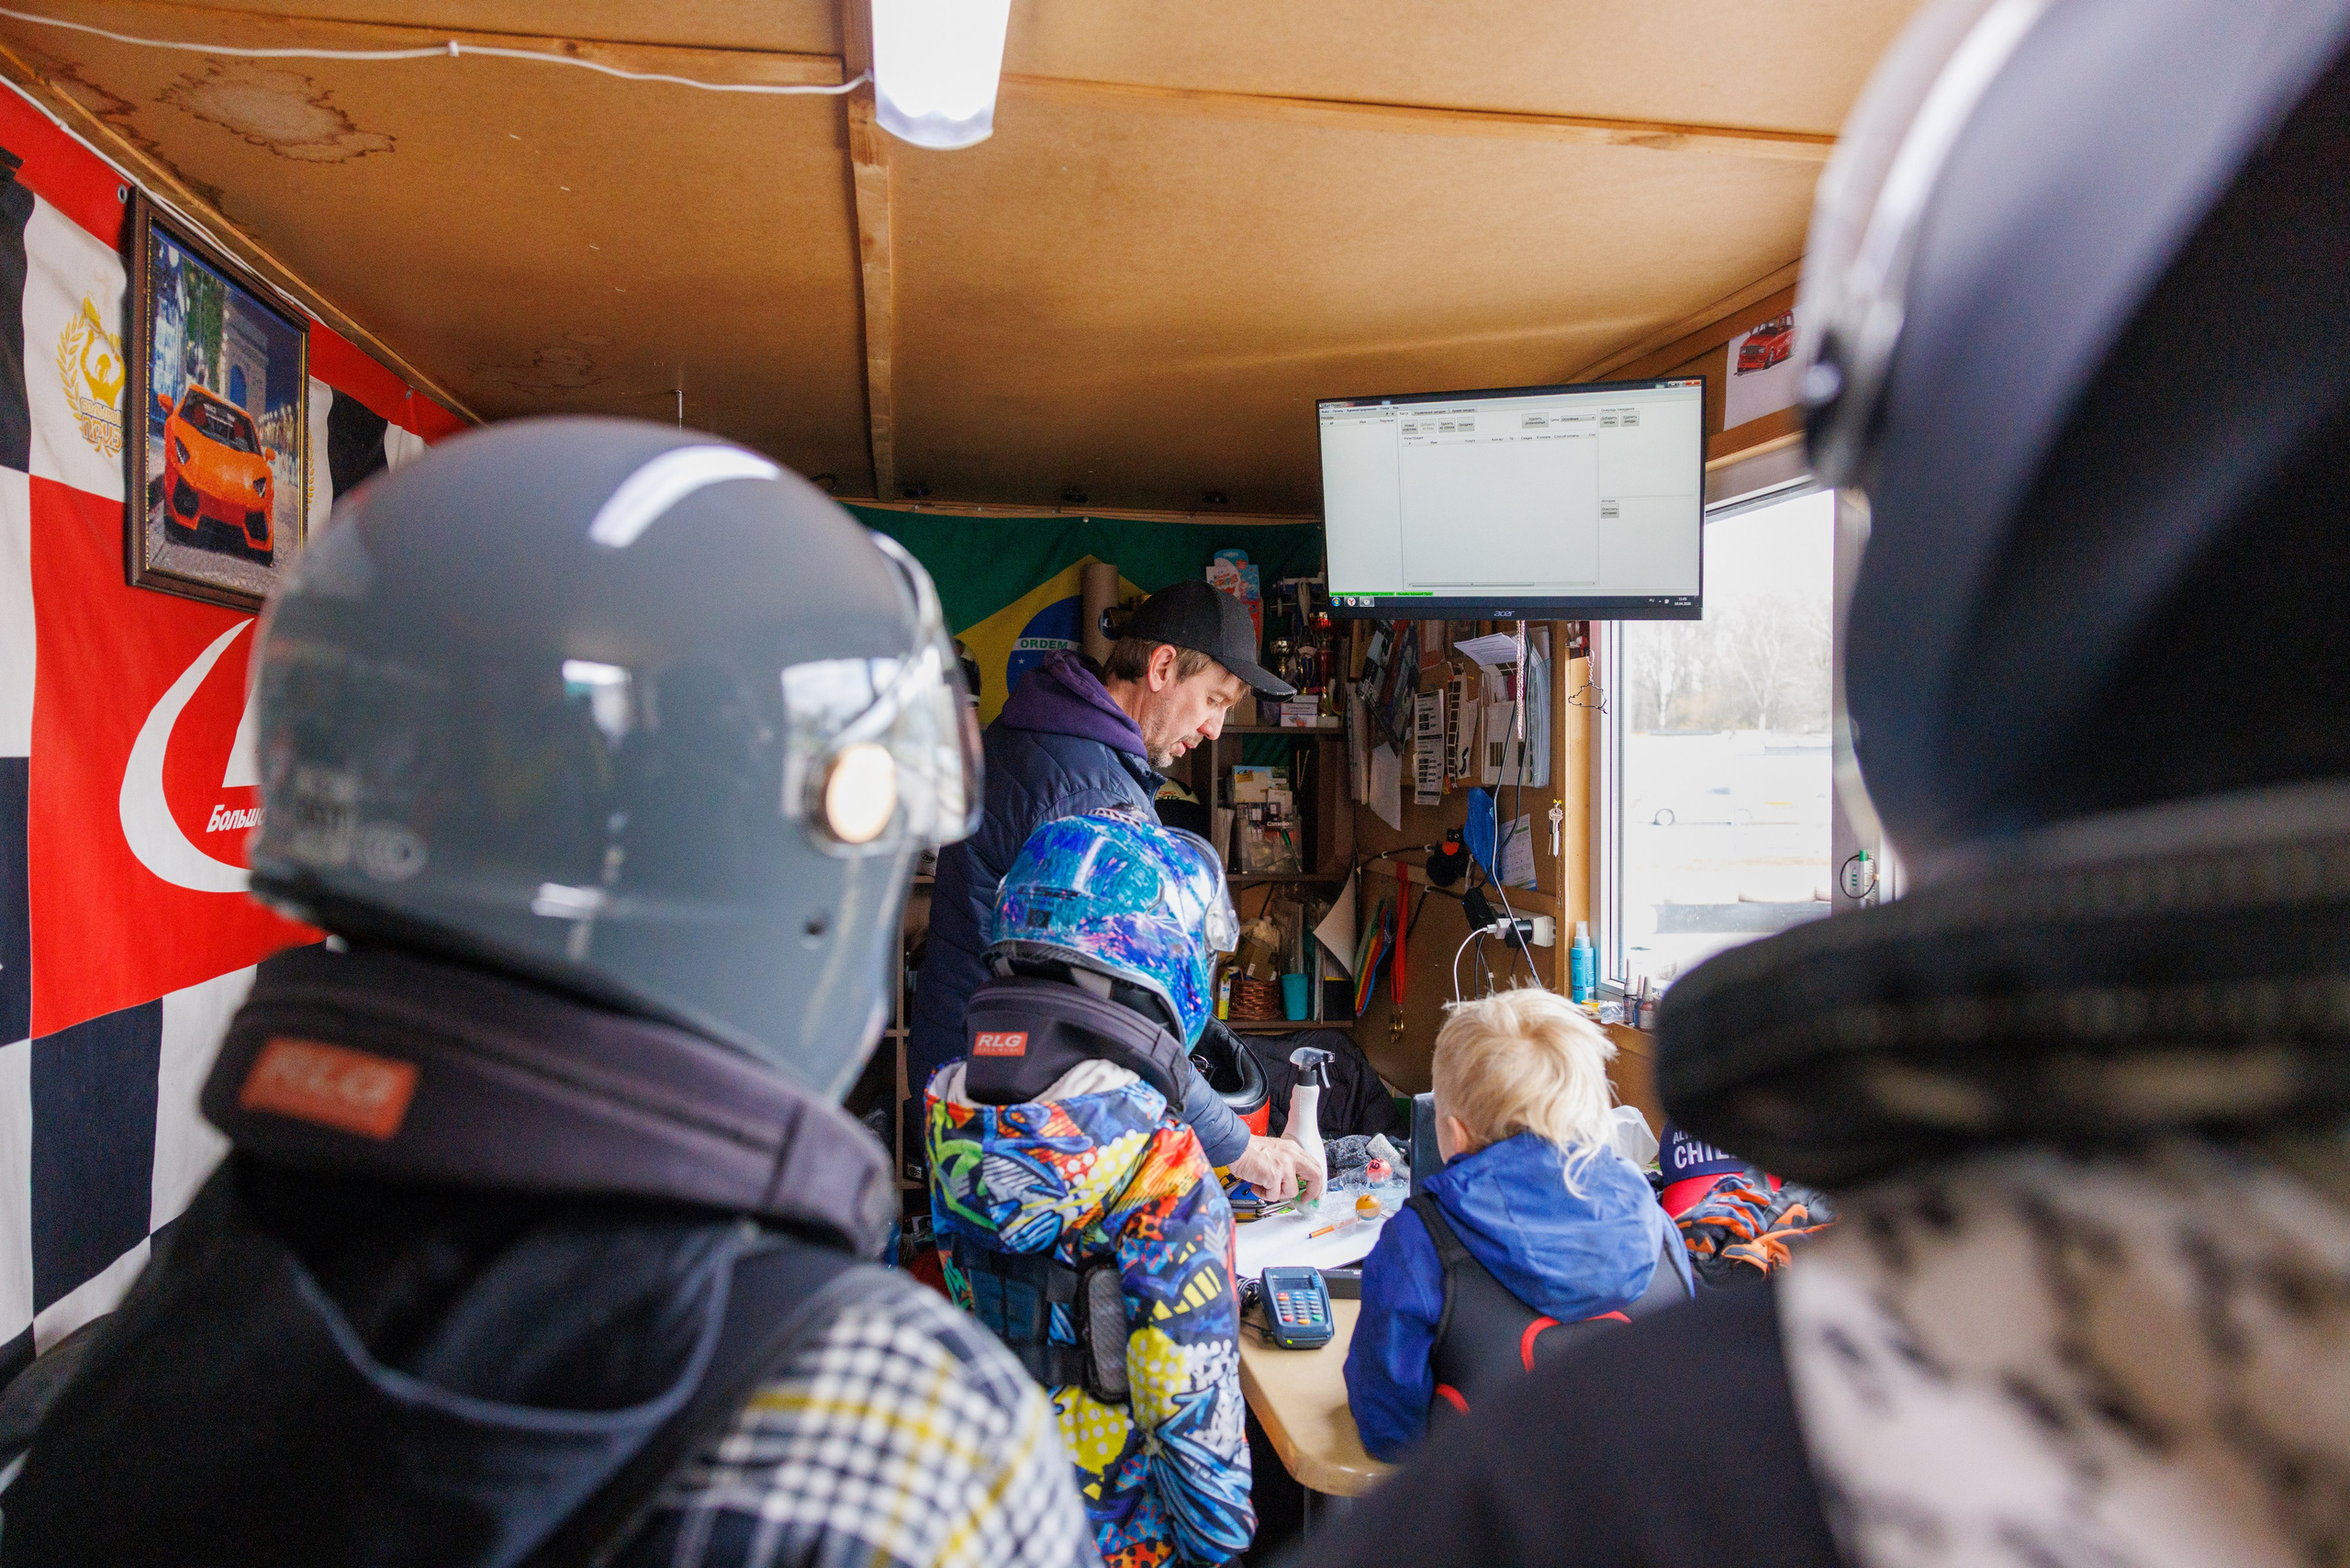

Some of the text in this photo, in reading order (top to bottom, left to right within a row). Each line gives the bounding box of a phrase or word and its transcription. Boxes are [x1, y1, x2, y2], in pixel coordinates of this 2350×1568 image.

[1021, 639, 1069, 650] ORDEM
[978, 1035, 1022, 1047] RLG
[1674, 1140, 1737, 1170] CHIL
